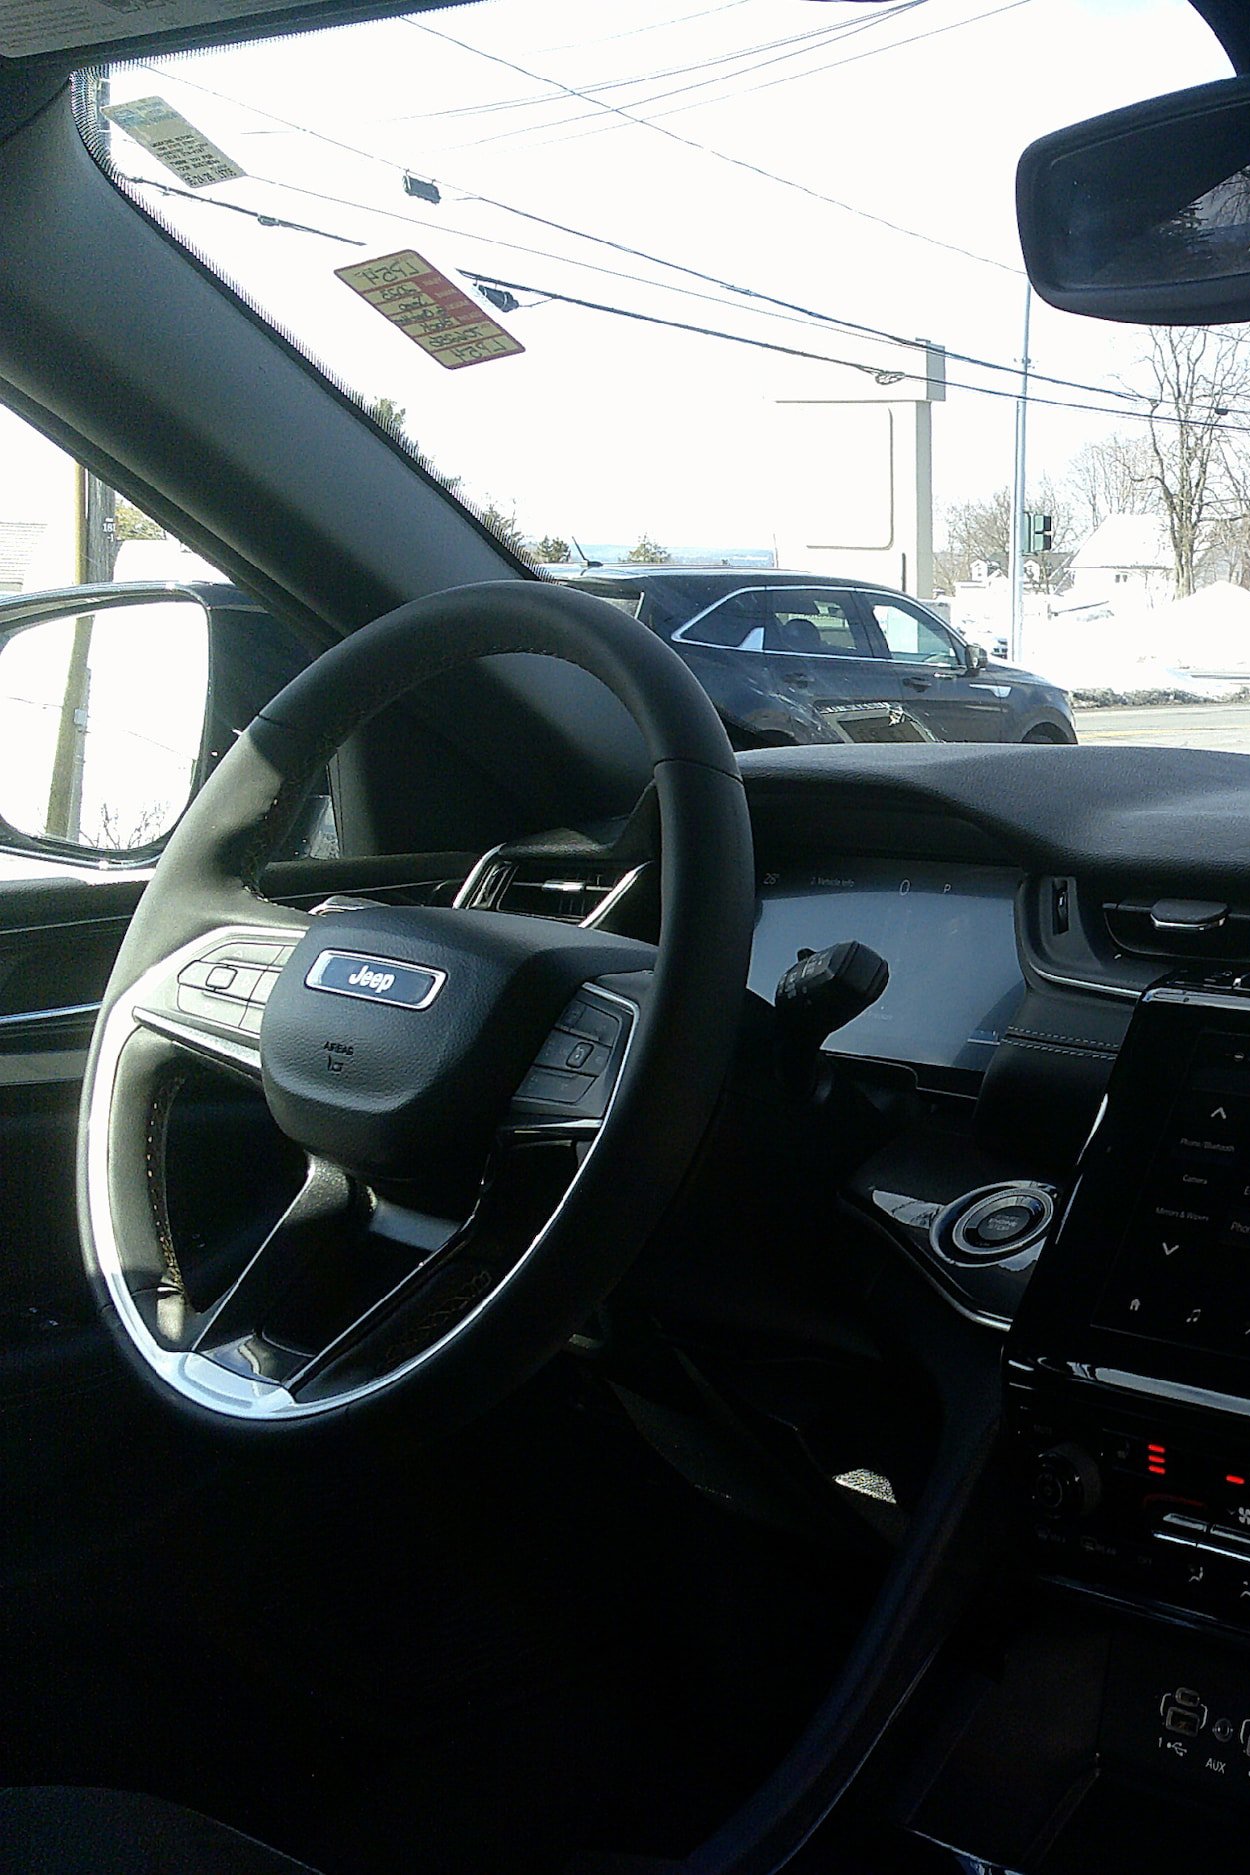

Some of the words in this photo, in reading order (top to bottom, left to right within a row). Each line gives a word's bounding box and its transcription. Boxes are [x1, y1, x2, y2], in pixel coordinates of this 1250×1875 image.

[942, 881, 952, 894] P
[348, 964, 395, 994] Jeep
[324, 1040, 354, 1056] AIRBAG
[1204, 1757, 1228, 1775] AUX
